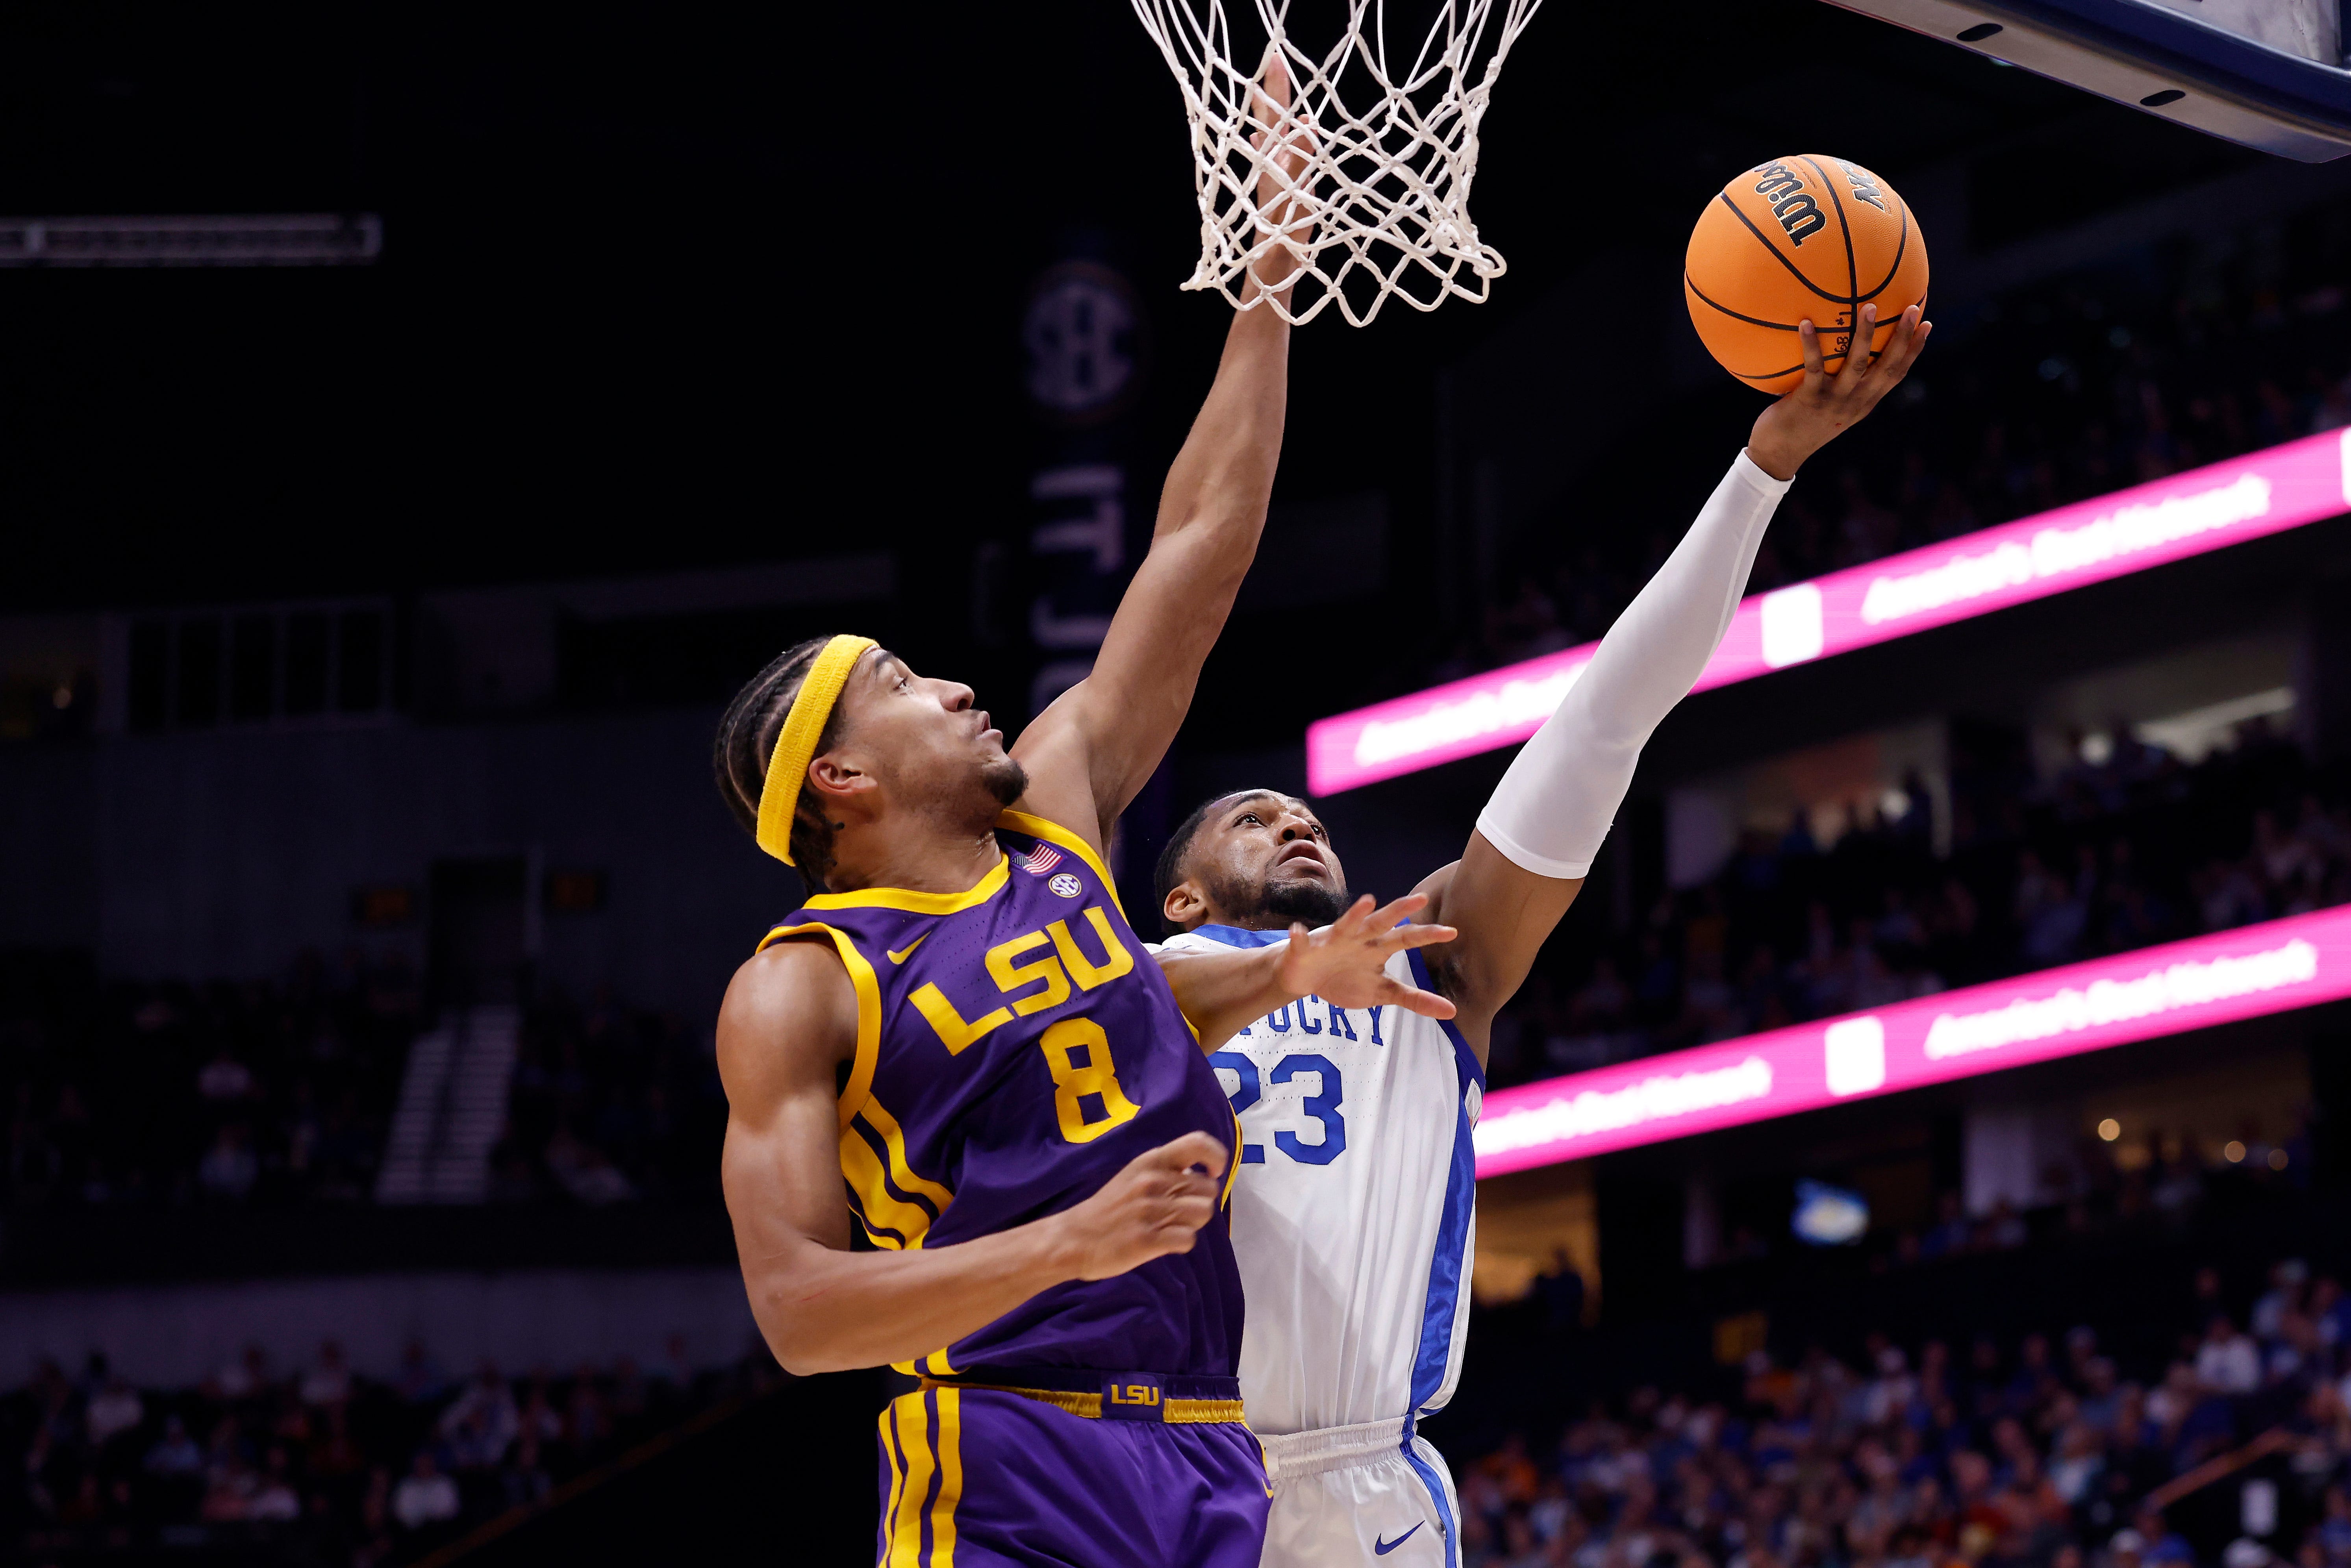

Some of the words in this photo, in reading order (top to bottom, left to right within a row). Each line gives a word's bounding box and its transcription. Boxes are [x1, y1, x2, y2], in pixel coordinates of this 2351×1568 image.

[1051, 875, 1079, 896] SEC
[908, 905, 1134, 1056] LSU
[1039, 1017, 1141, 1144] 8
[1207, 1051, 1346, 1165] 23
[1111, 1384, 1160, 1407] LSU
